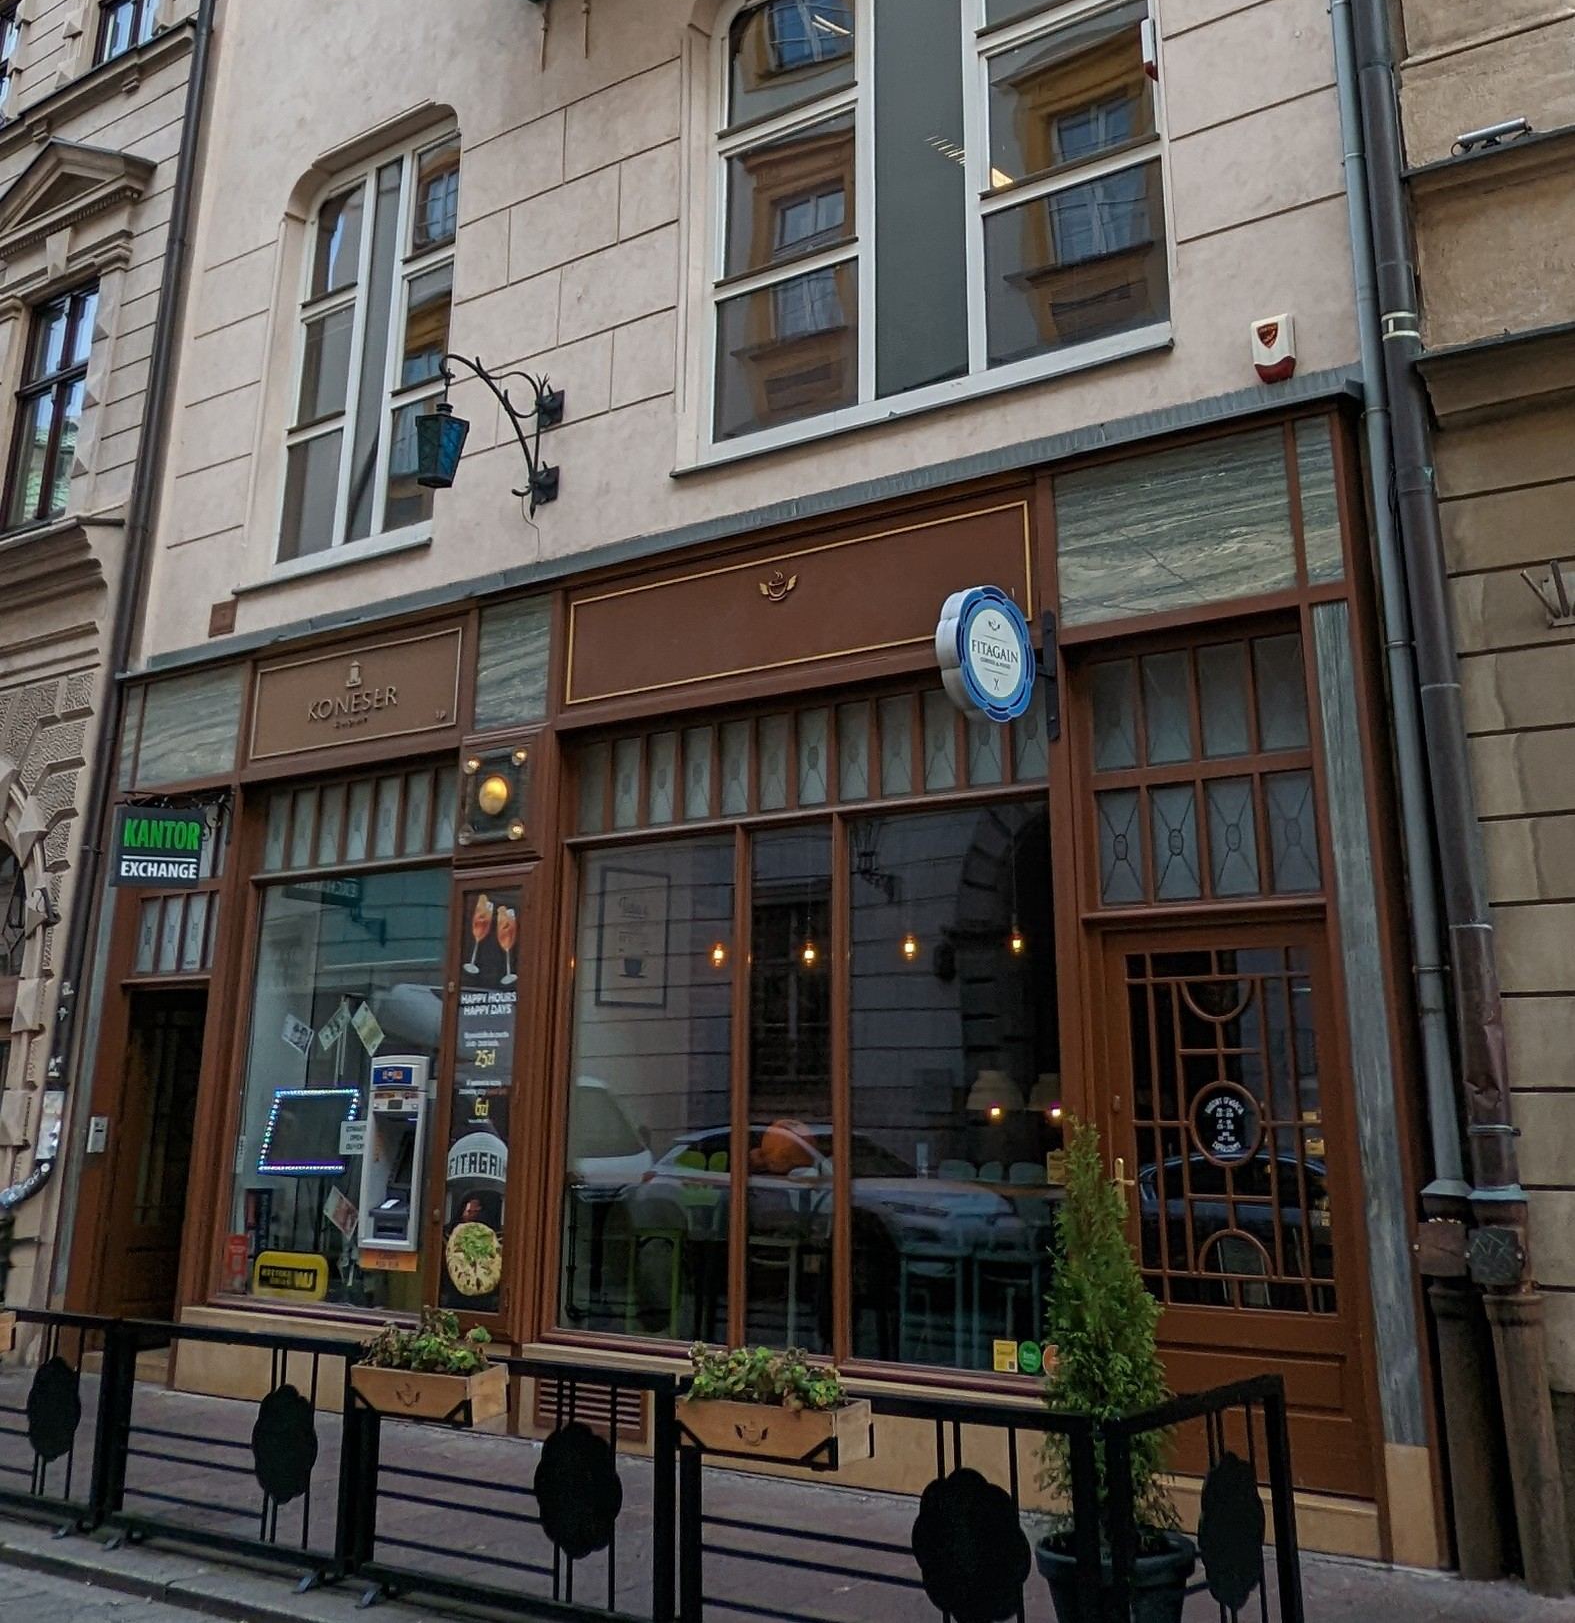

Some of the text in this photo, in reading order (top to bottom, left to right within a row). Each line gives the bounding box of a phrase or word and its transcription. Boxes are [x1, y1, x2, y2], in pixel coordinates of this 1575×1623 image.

[971, 639, 1018, 664] FITAGAIN
[307, 685, 399, 722] KONESER
[123, 818, 201, 850] KANTOR
[121, 861, 198, 879] EXCHANGE
[461, 991, 517, 1005] HAPPY HOURS
[463, 1004, 513, 1016] HAPPY DAYS
